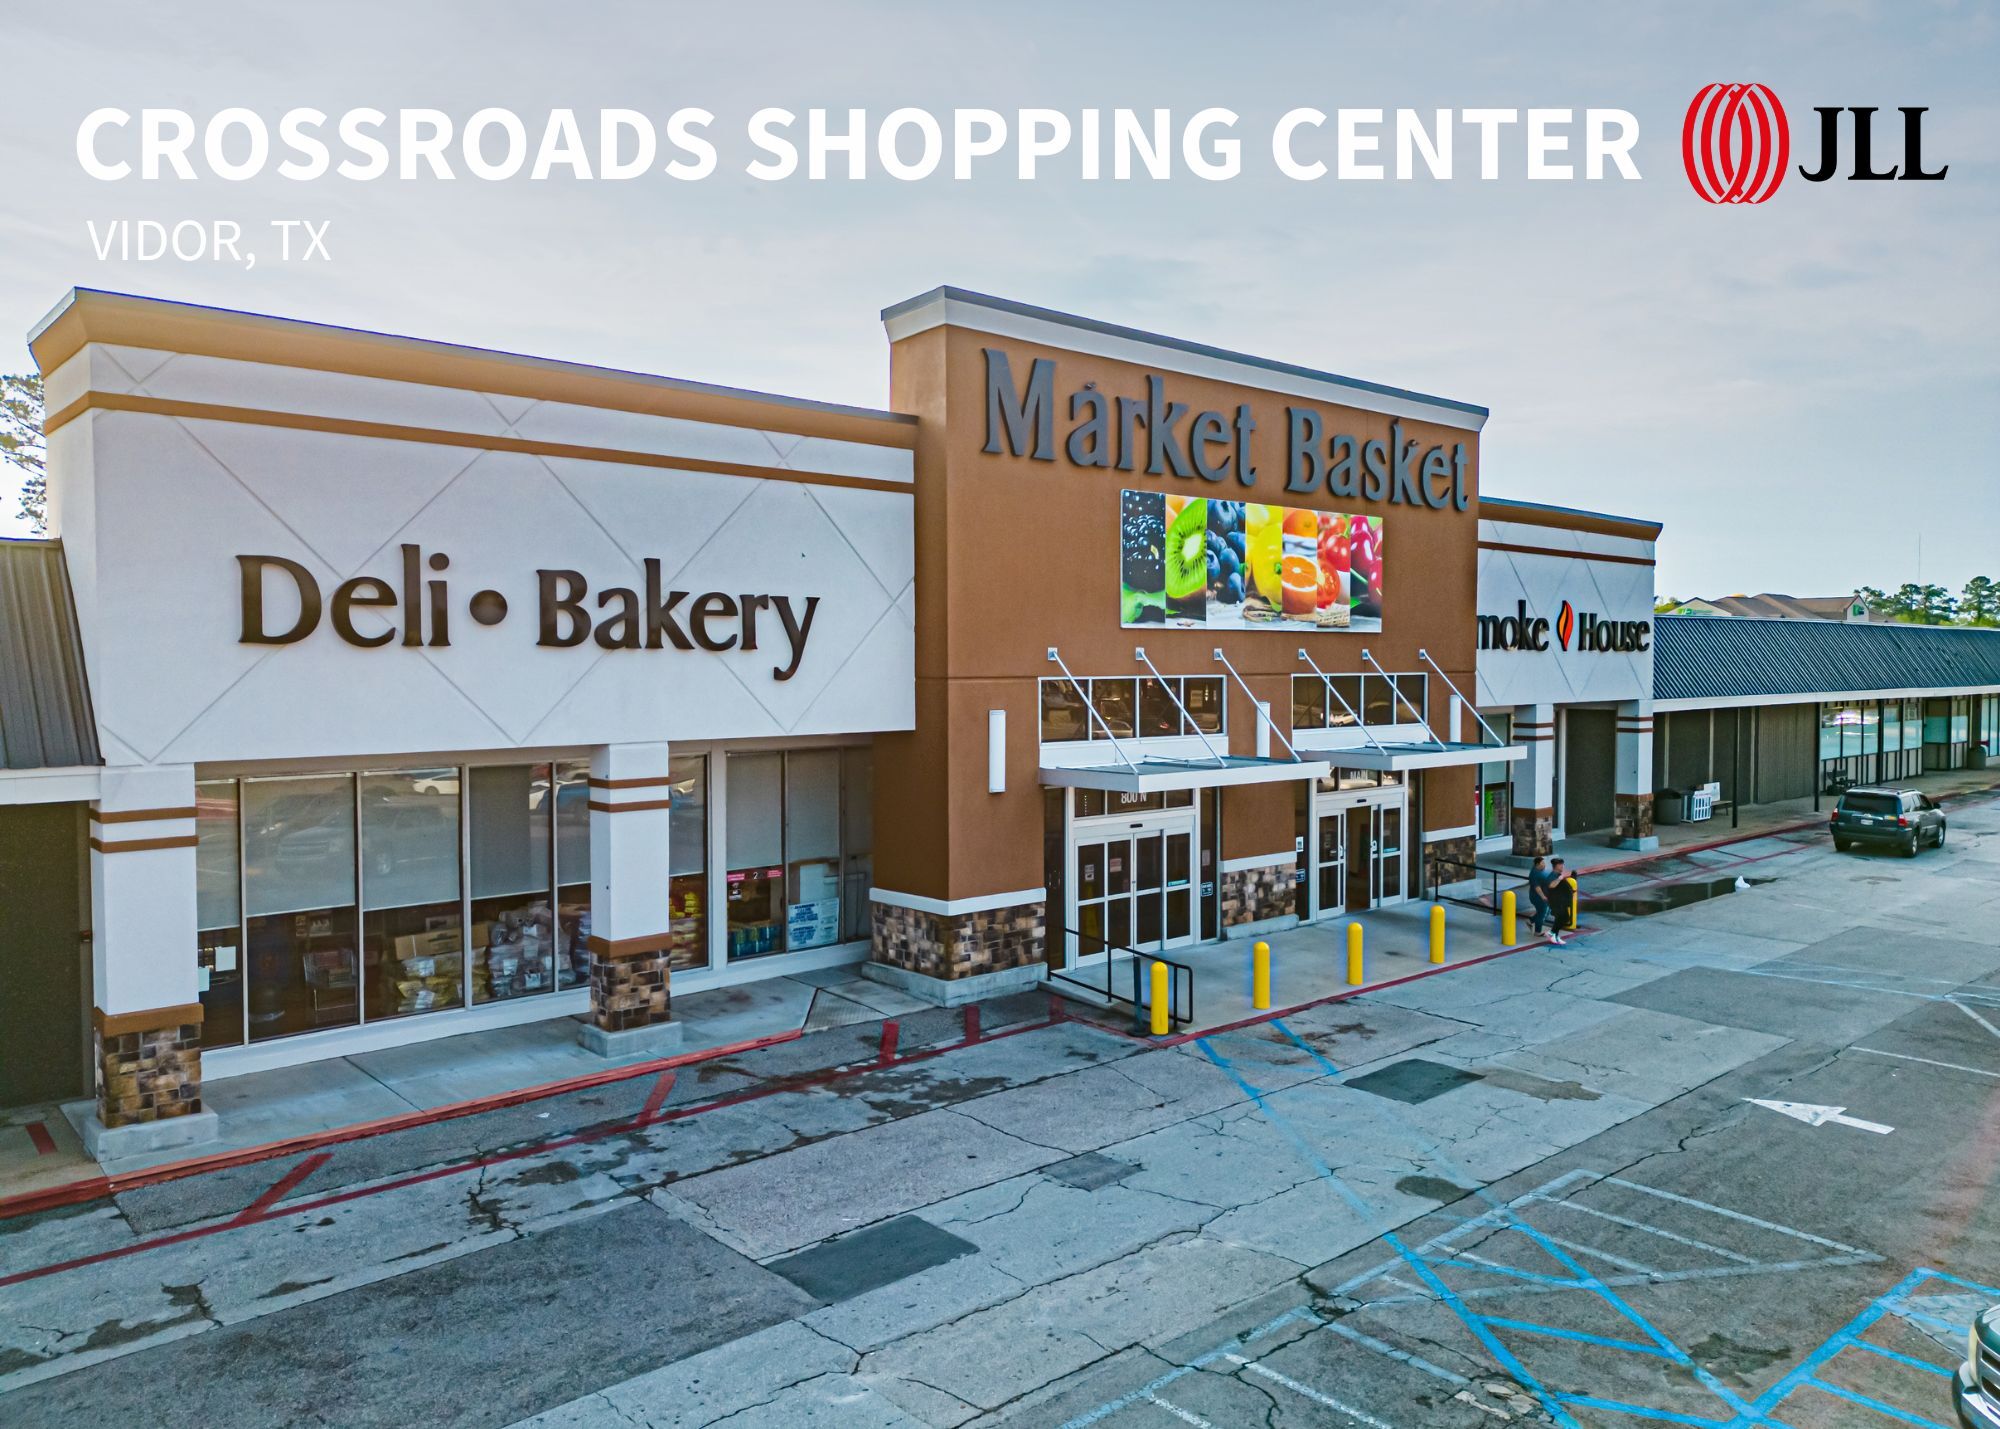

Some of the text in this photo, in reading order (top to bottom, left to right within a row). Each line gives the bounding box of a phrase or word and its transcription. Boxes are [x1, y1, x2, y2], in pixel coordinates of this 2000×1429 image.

[981, 347, 1471, 512] Market Basket
[235, 543, 821, 682] Deli Bakery
[1477, 599, 1651, 653] moke House
